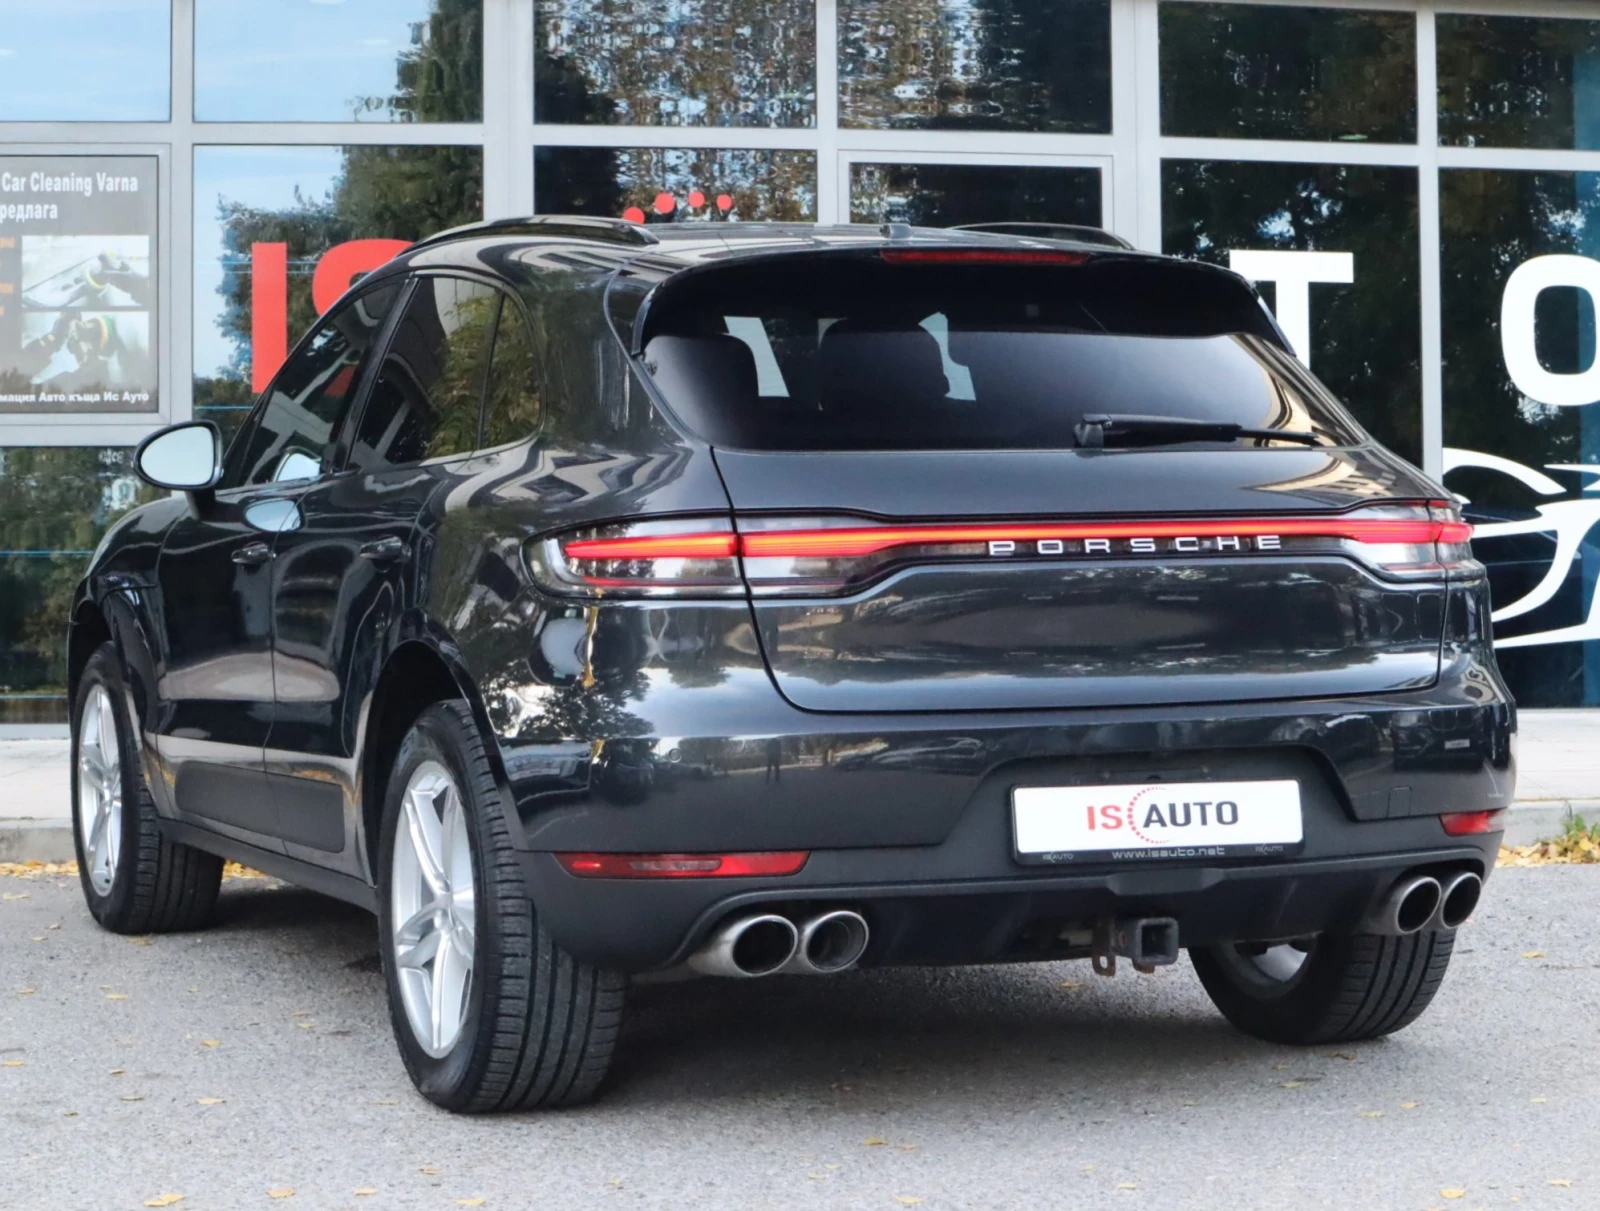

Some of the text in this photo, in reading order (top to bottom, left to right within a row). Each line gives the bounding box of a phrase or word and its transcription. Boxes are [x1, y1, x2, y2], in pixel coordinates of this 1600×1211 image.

[2, 172, 138, 197] Car Cleaning Varna
[988, 535, 1281, 556] PORSCHE
[1087, 801, 1239, 830] IS AUTO
[1112, 846, 1225, 859] www.isauto.net
